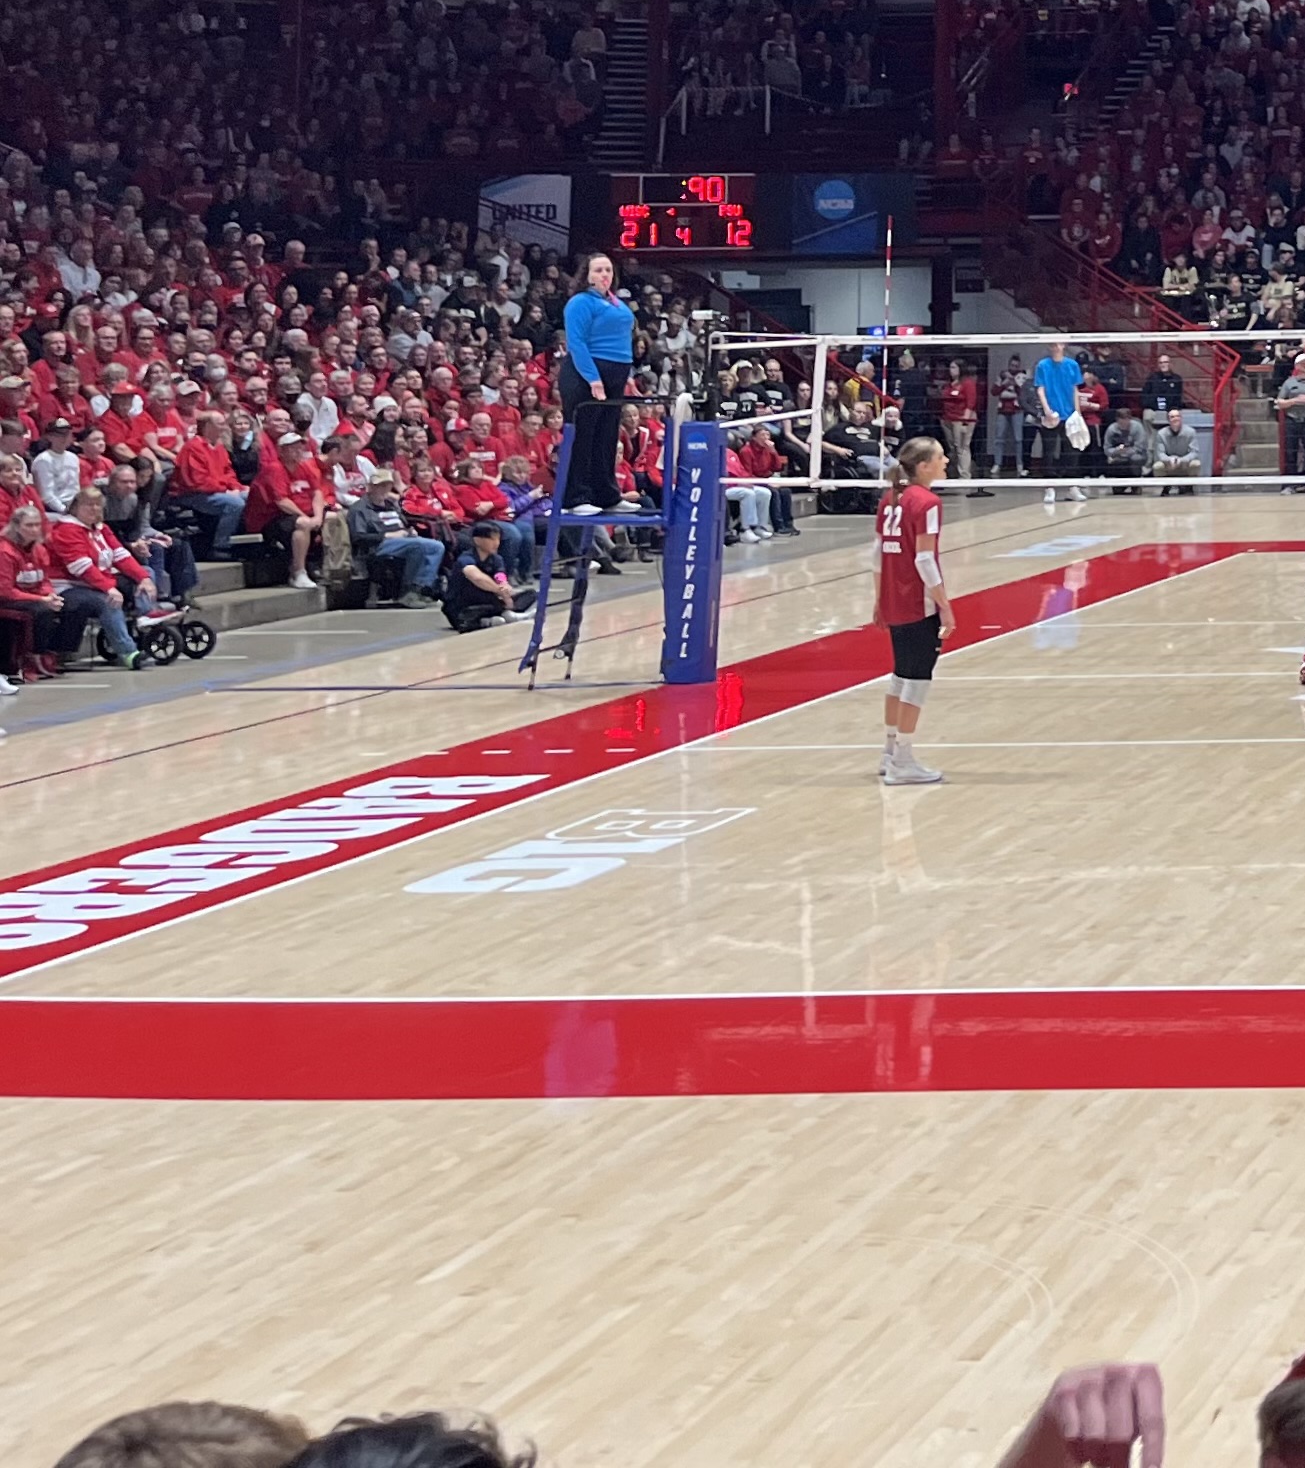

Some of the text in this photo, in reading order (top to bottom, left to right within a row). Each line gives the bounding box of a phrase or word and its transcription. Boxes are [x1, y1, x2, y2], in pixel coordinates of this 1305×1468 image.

[676, 226, 692, 247] 4
[727, 219, 752, 247] 12
[882, 505, 902, 536] 22
[678, 467, 702, 659] VOLLEYBALL
